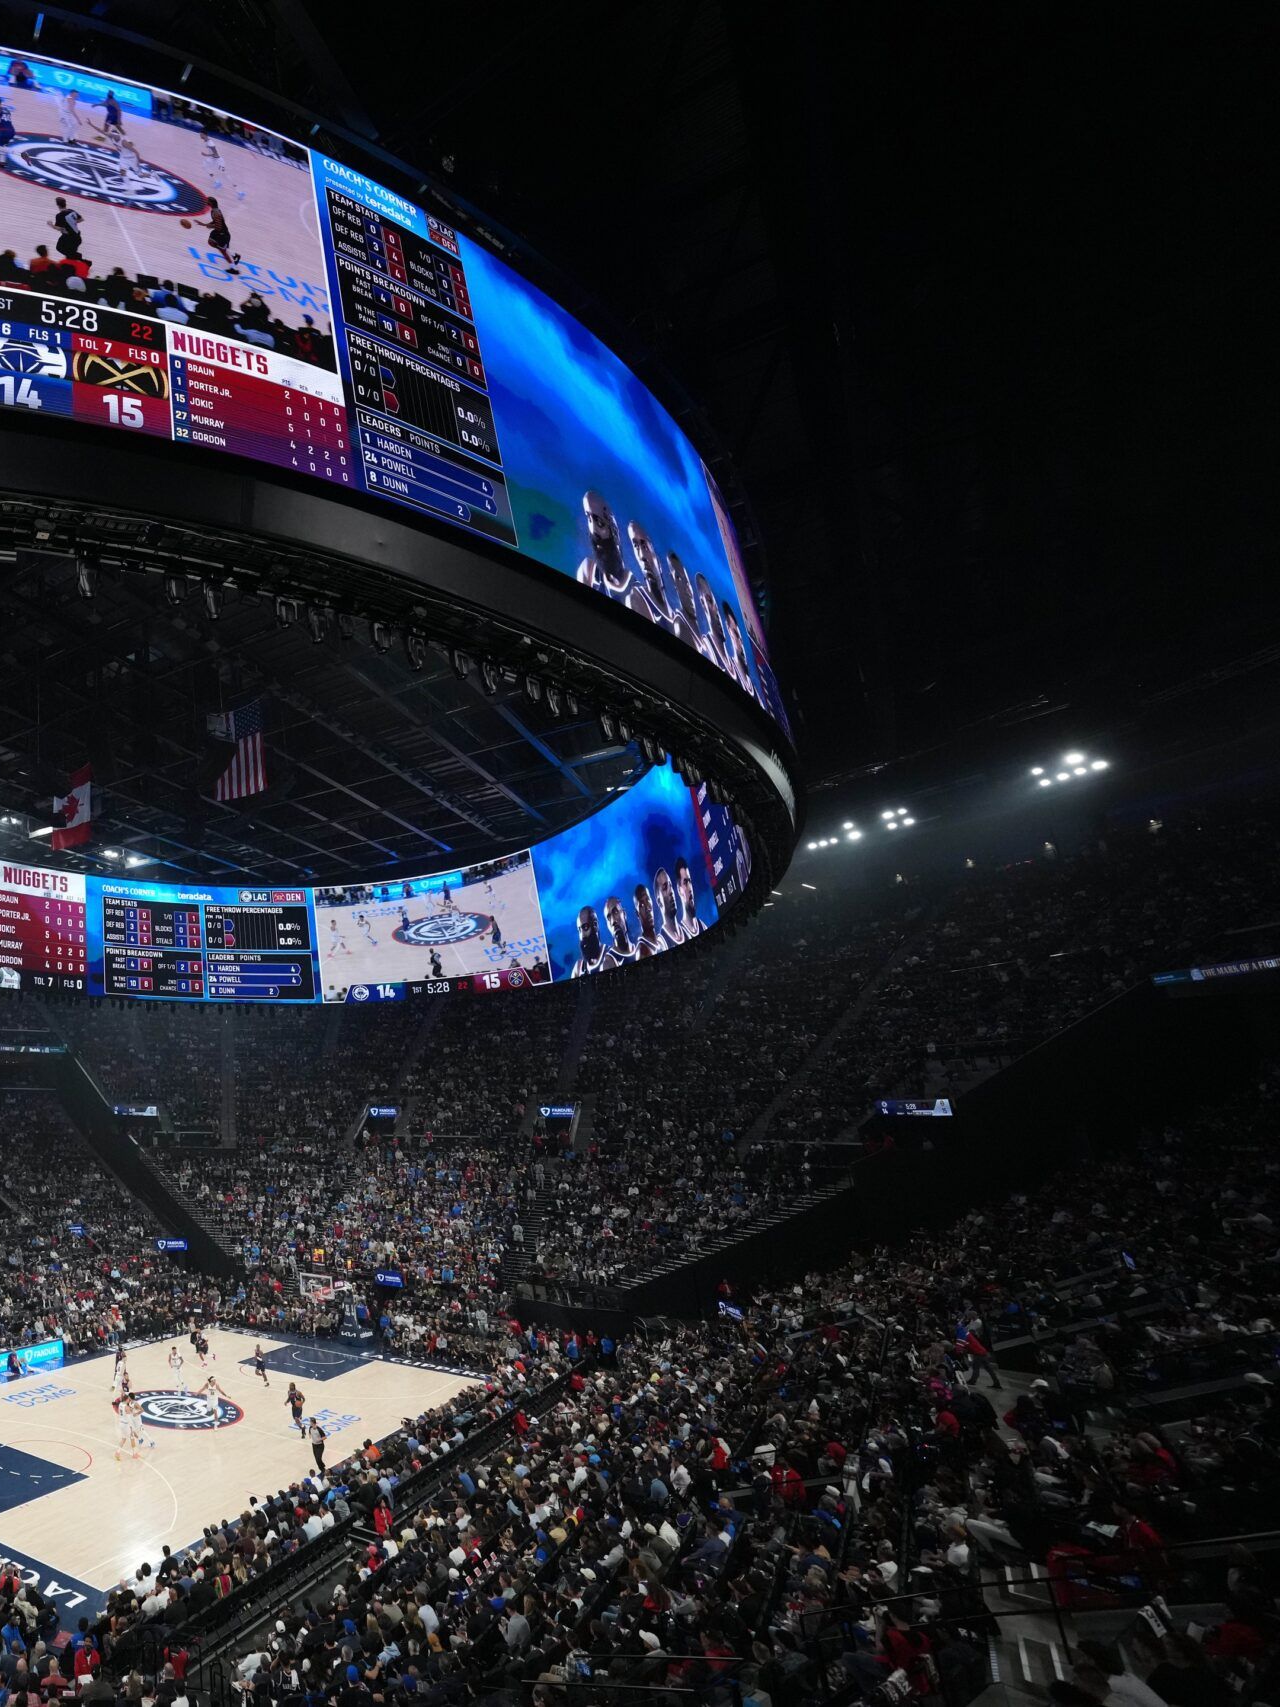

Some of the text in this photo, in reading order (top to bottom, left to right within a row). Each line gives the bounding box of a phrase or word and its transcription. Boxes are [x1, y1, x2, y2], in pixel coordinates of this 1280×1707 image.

[323, 159, 417, 217] COACH'S CORNER
[330, 192, 379, 222] TEAM STATS
[332, 206, 361, 226] OFF REB
[335, 223, 364, 243] DEF REB
[440, 224, 453, 238] LAC
[338, 241, 366, 260] ASSISTS
[442, 239, 456, 252] DEN
[420, 251, 431, 263] T/O
[410, 261, 433, 280] BLOCKS
[340, 258, 425, 307] POINTS BREAKDOWN
[356, 278, 370, 289] FAST
[414, 279, 436, 297] STEALS
[353, 285, 373, 299] BREAK
[41, 301, 98, 332] 5:28
[2, 324, 11, 335] 6
[29, 329, 60, 343] FLS 1
[131, 323, 152, 340] 22
[79, 338, 112, 353] TOL 7
[172, 331, 268, 374] NUGGETS
[129, 348, 159, 363] FLS 0
[351, 335, 460, 392] FREE THROW PERCENTAGES
[188, 364, 214, 377] BRAUN
[177, 377, 232, 397] 1 PORTER JR.
[175, 394, 213, 409] 15 JOKIC
[103, 394, 144, 428] 15
[176, 411, 224, 429] 27 MURRAY
[177, 429, 226, 446] 32 GORDON
[361, 414, 440, 453] LEADERS POINTS
[365, 433, 412, 459] 1 HARDEN
[365, 451, 416, 478] 24 POWELL
[370, 471, 408, 493] 8 DUNN
[3, 866, 68, 892] NUGGETS
[102, 885, 155, 896] COACH'S CORNER
[34, 977, 53, 987] TOL 7
[64, 980, 82, 989] FLS 0
[427, 983, 450, 994] 5:28
[482, 974, 500, 989] 15
[377, 985, 395, 998] 14
[34, 1347, 59, 1358] FANDUEL
[361, 1352, 383, 1360] LA
[2, 1384, 56, 1402] INTUIT
